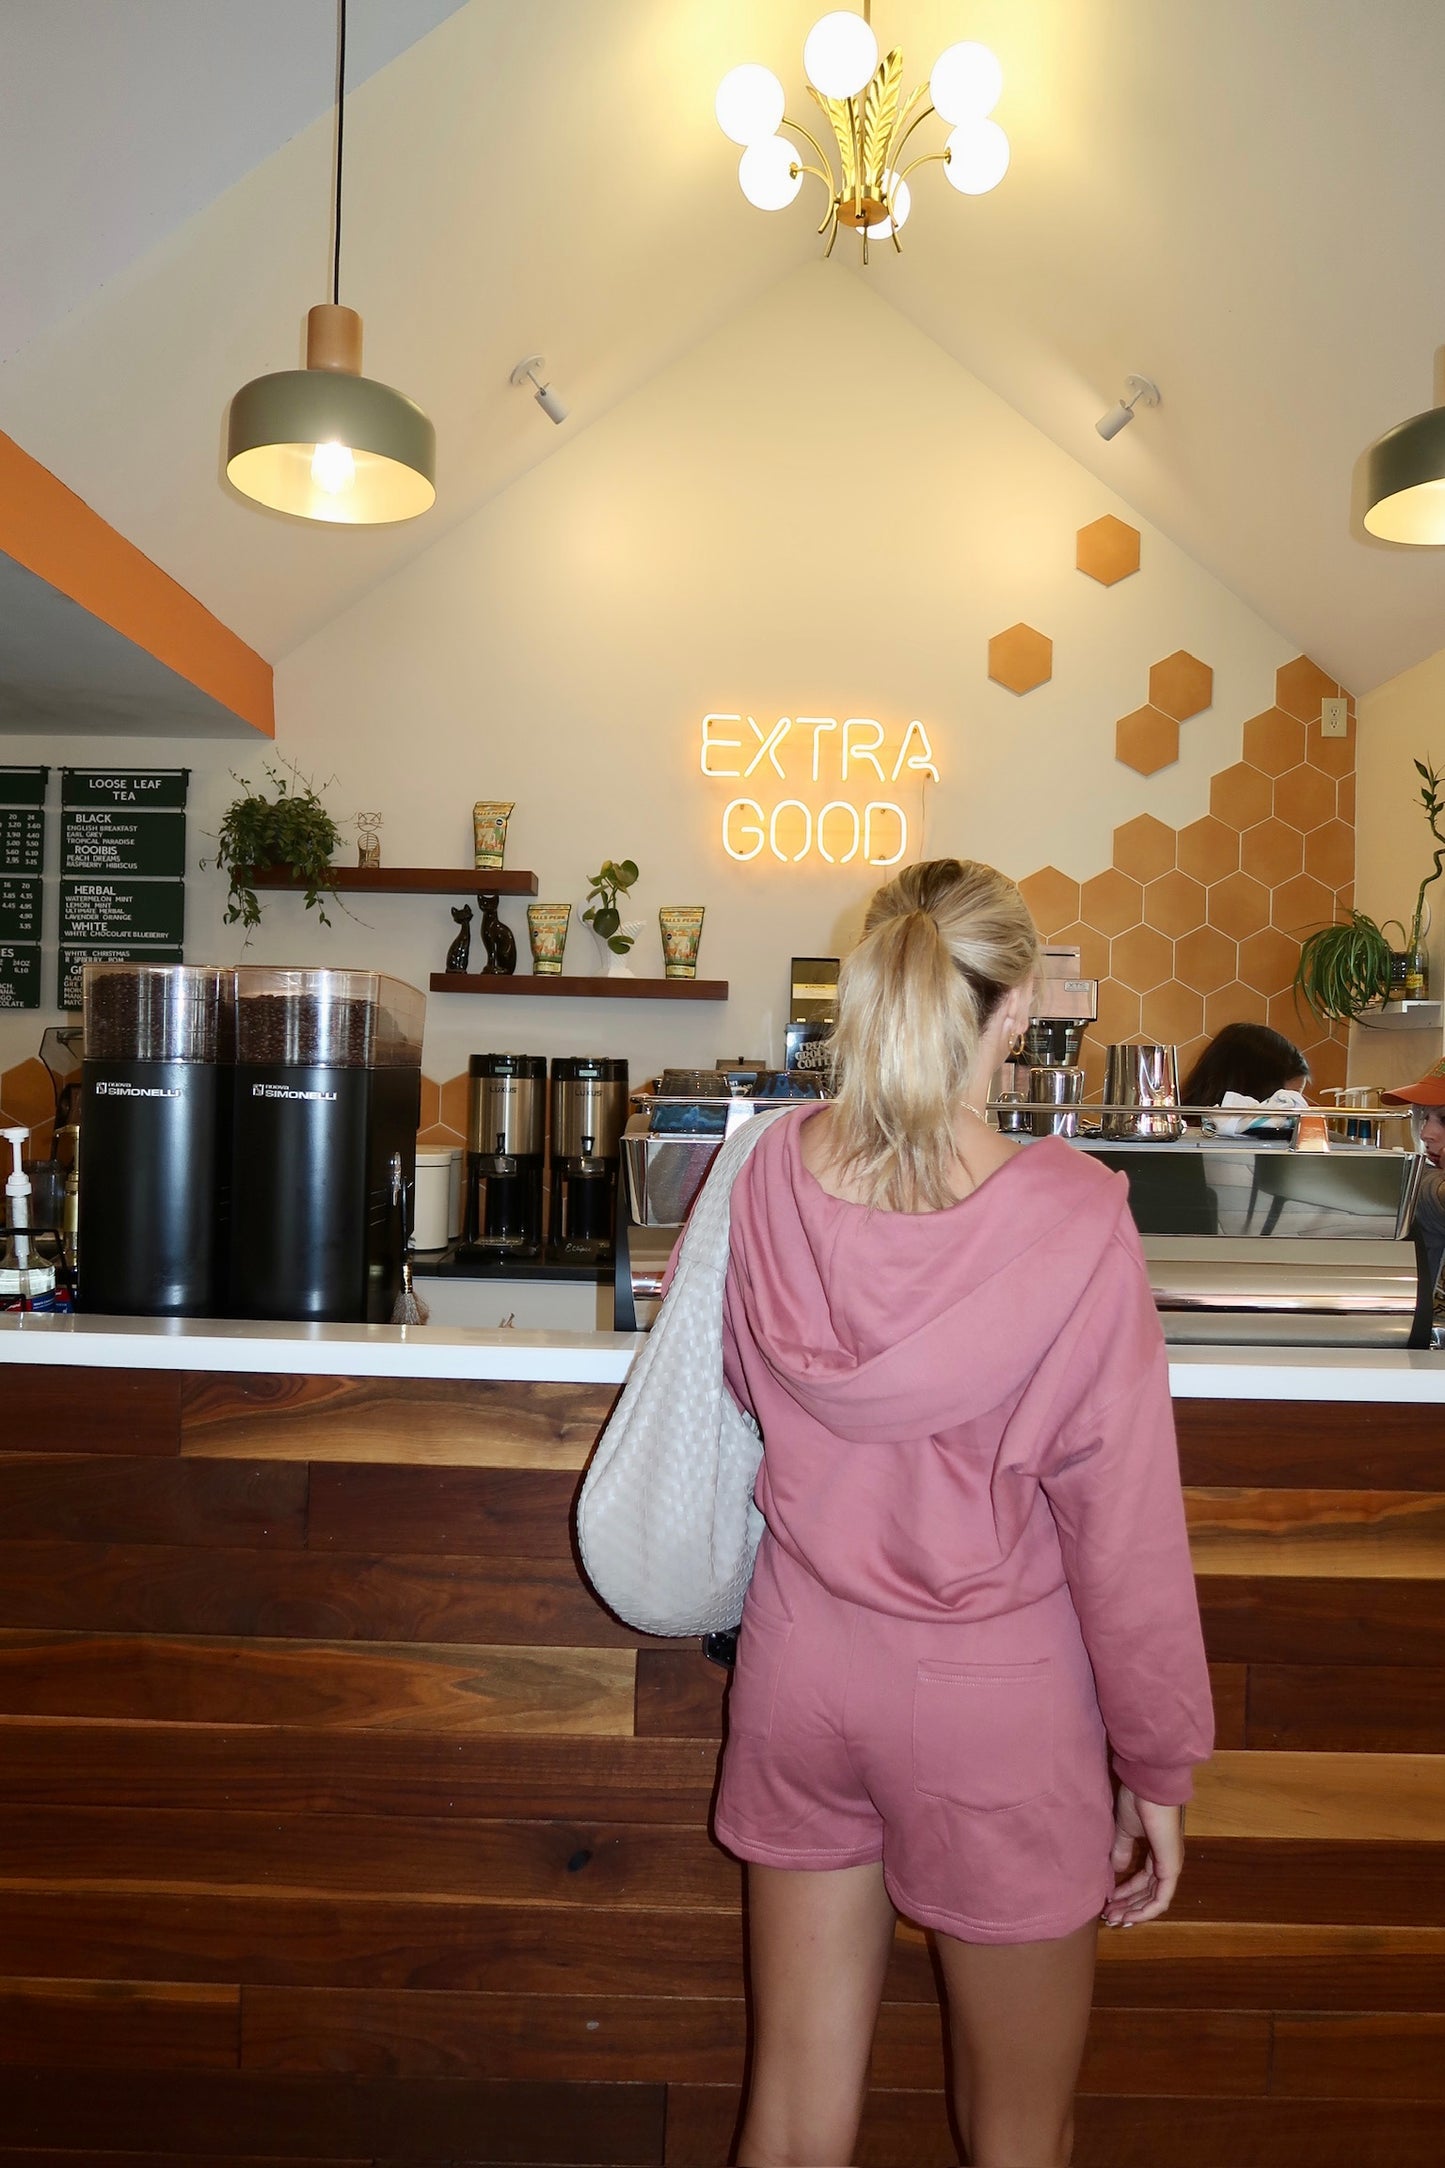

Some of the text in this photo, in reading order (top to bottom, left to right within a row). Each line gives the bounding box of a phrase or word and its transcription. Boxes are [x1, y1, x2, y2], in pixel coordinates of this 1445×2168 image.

[700, 712, 941, 783] EXTRA
[89, 779, 162, 789] LOOSE LEAF
[113, 791, 136, 801] TEA
[75, 813, 112, 823] BLACK
[721, 797, 909, 867] GOOD
[75, 845, 118, 855] ROOIBIS
[66, 854, 90, 862] PEACH
[74, 885, 116, 896] HERBAL
[71, 921, 108, 931] WHITE
[132, 931, 169, 939] BLUEBERRY
[108, 1087, 181, 1097] SIMONELLI
[265, 1089, 338, 1101] SIMONELLI
[489, 1086, 518, 1094] LUXUS
